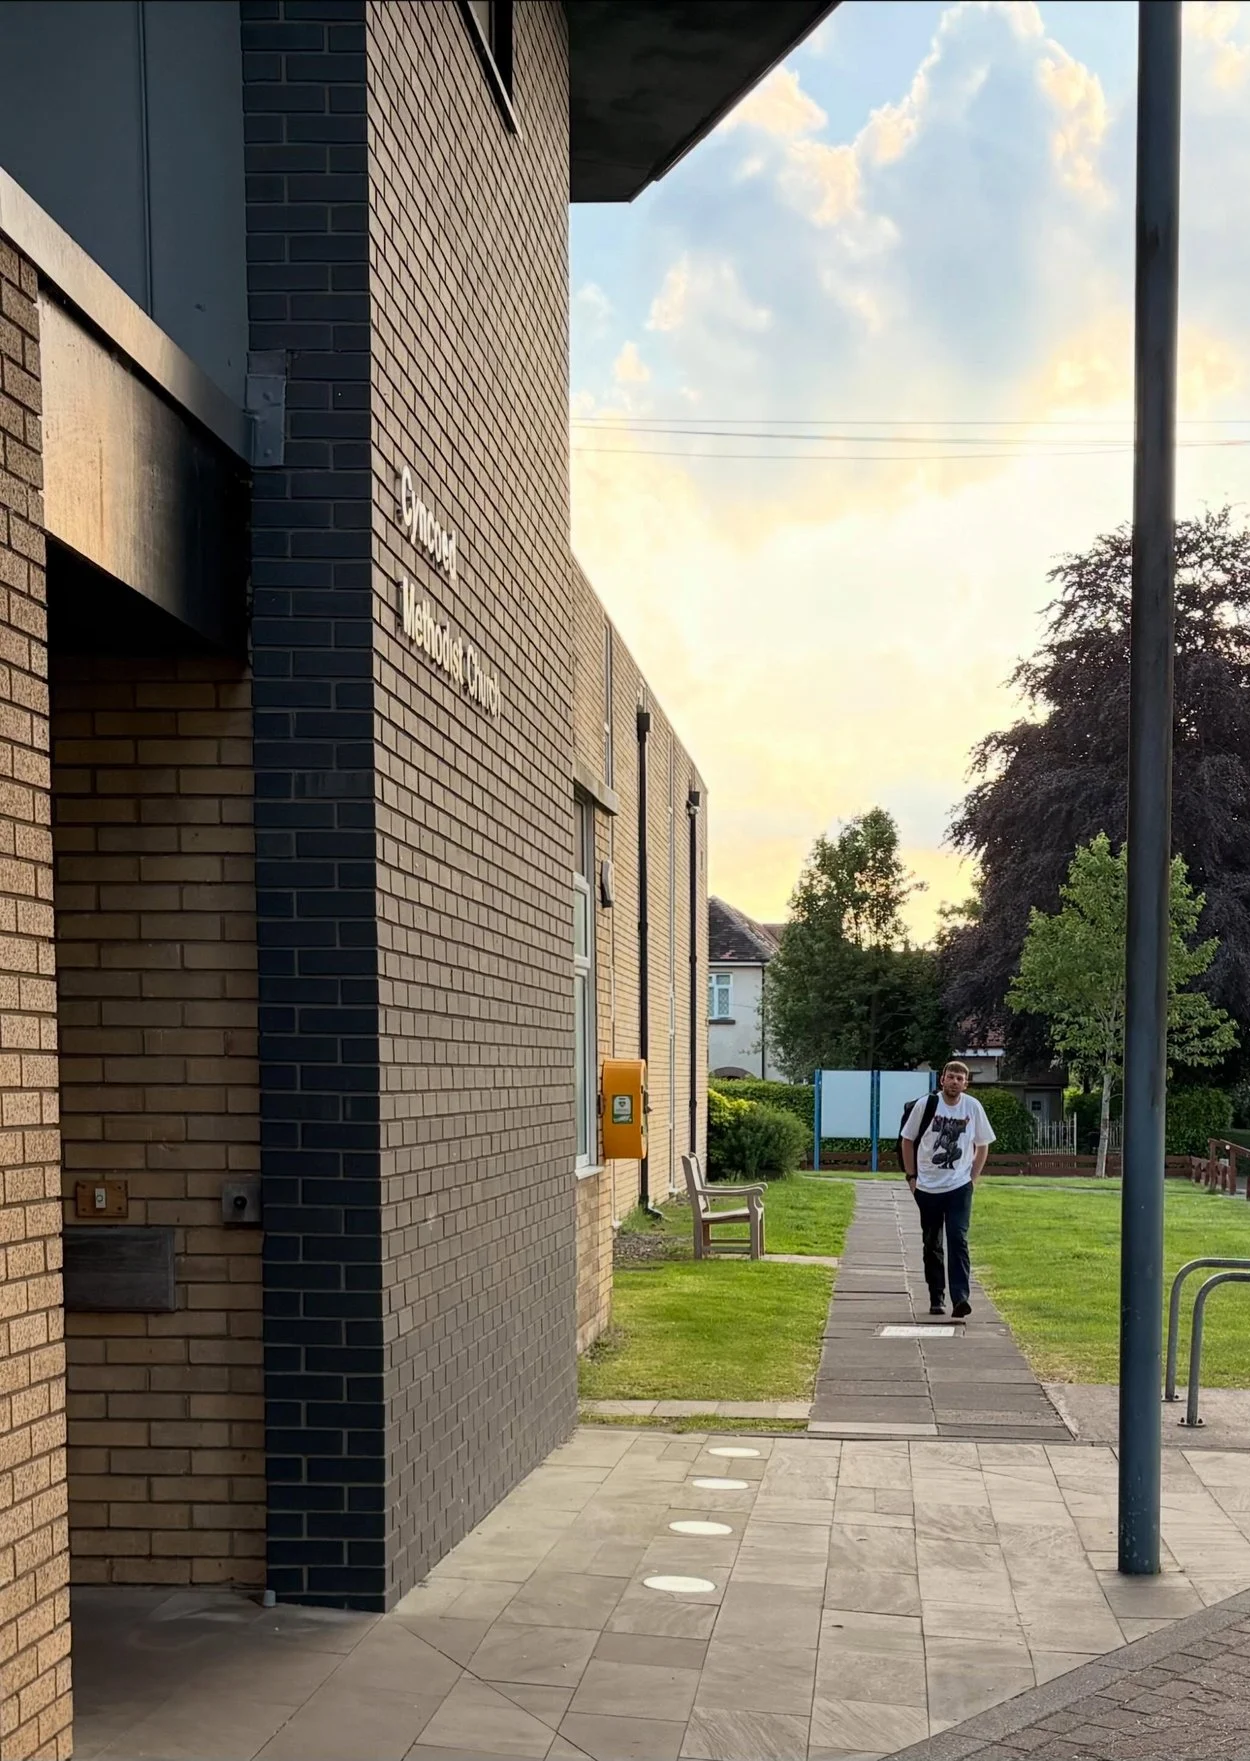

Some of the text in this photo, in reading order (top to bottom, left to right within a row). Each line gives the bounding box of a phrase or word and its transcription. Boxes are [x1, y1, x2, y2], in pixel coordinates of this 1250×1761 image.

[402, 465, 457, 580] Cyncoed
[403, 575, 500, 719] Methodist Church
